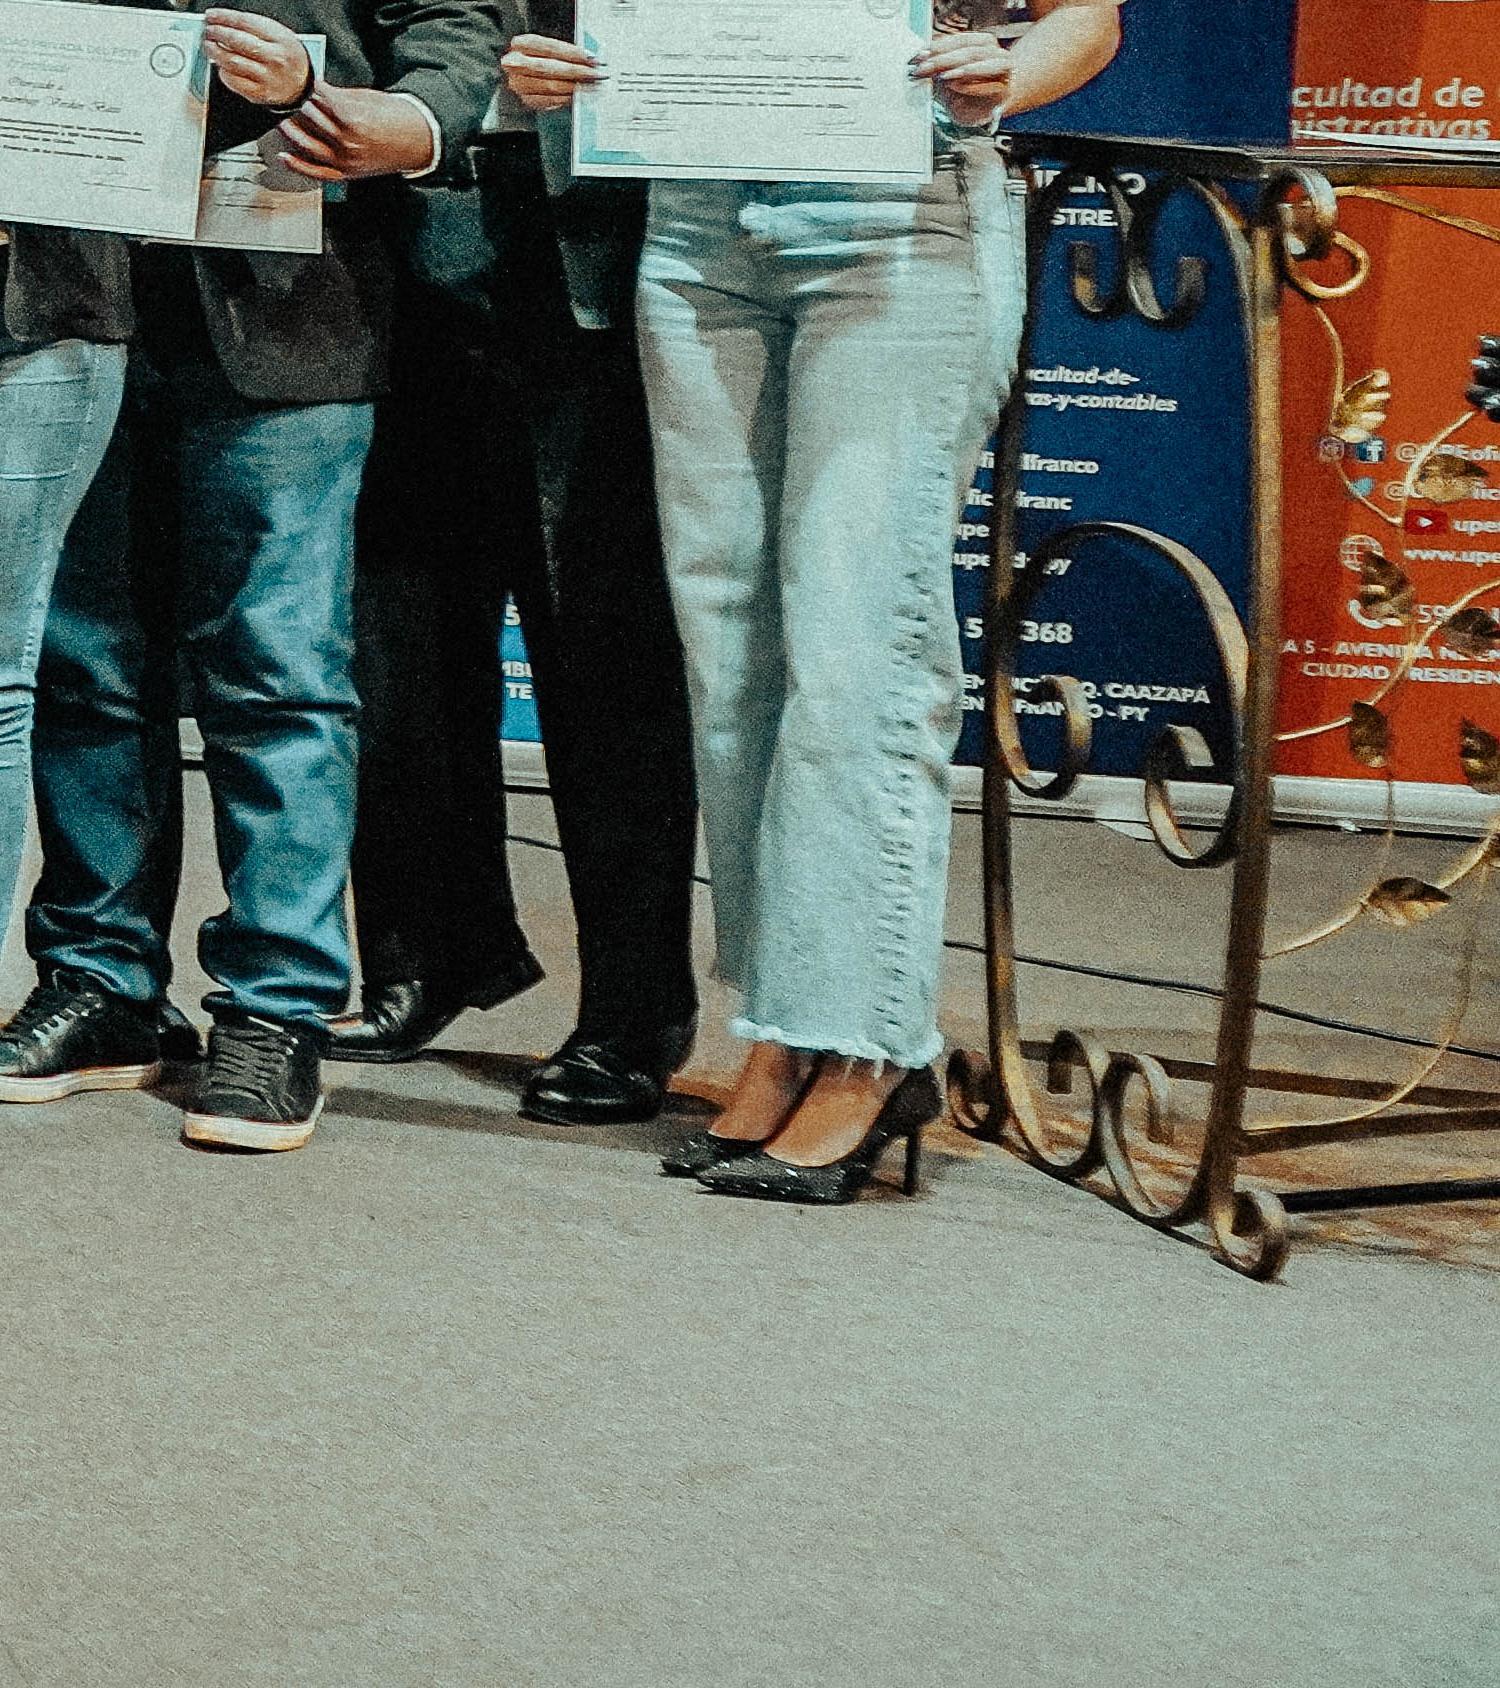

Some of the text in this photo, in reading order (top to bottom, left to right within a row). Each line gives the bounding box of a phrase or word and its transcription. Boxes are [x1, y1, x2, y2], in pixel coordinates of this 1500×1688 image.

[1435, 77, 1485, 108] de
[1303, 662, 1500, 685] CIUDAD RESIDEN
[1104, 680, 1211, 704] CAAZAPÁ
